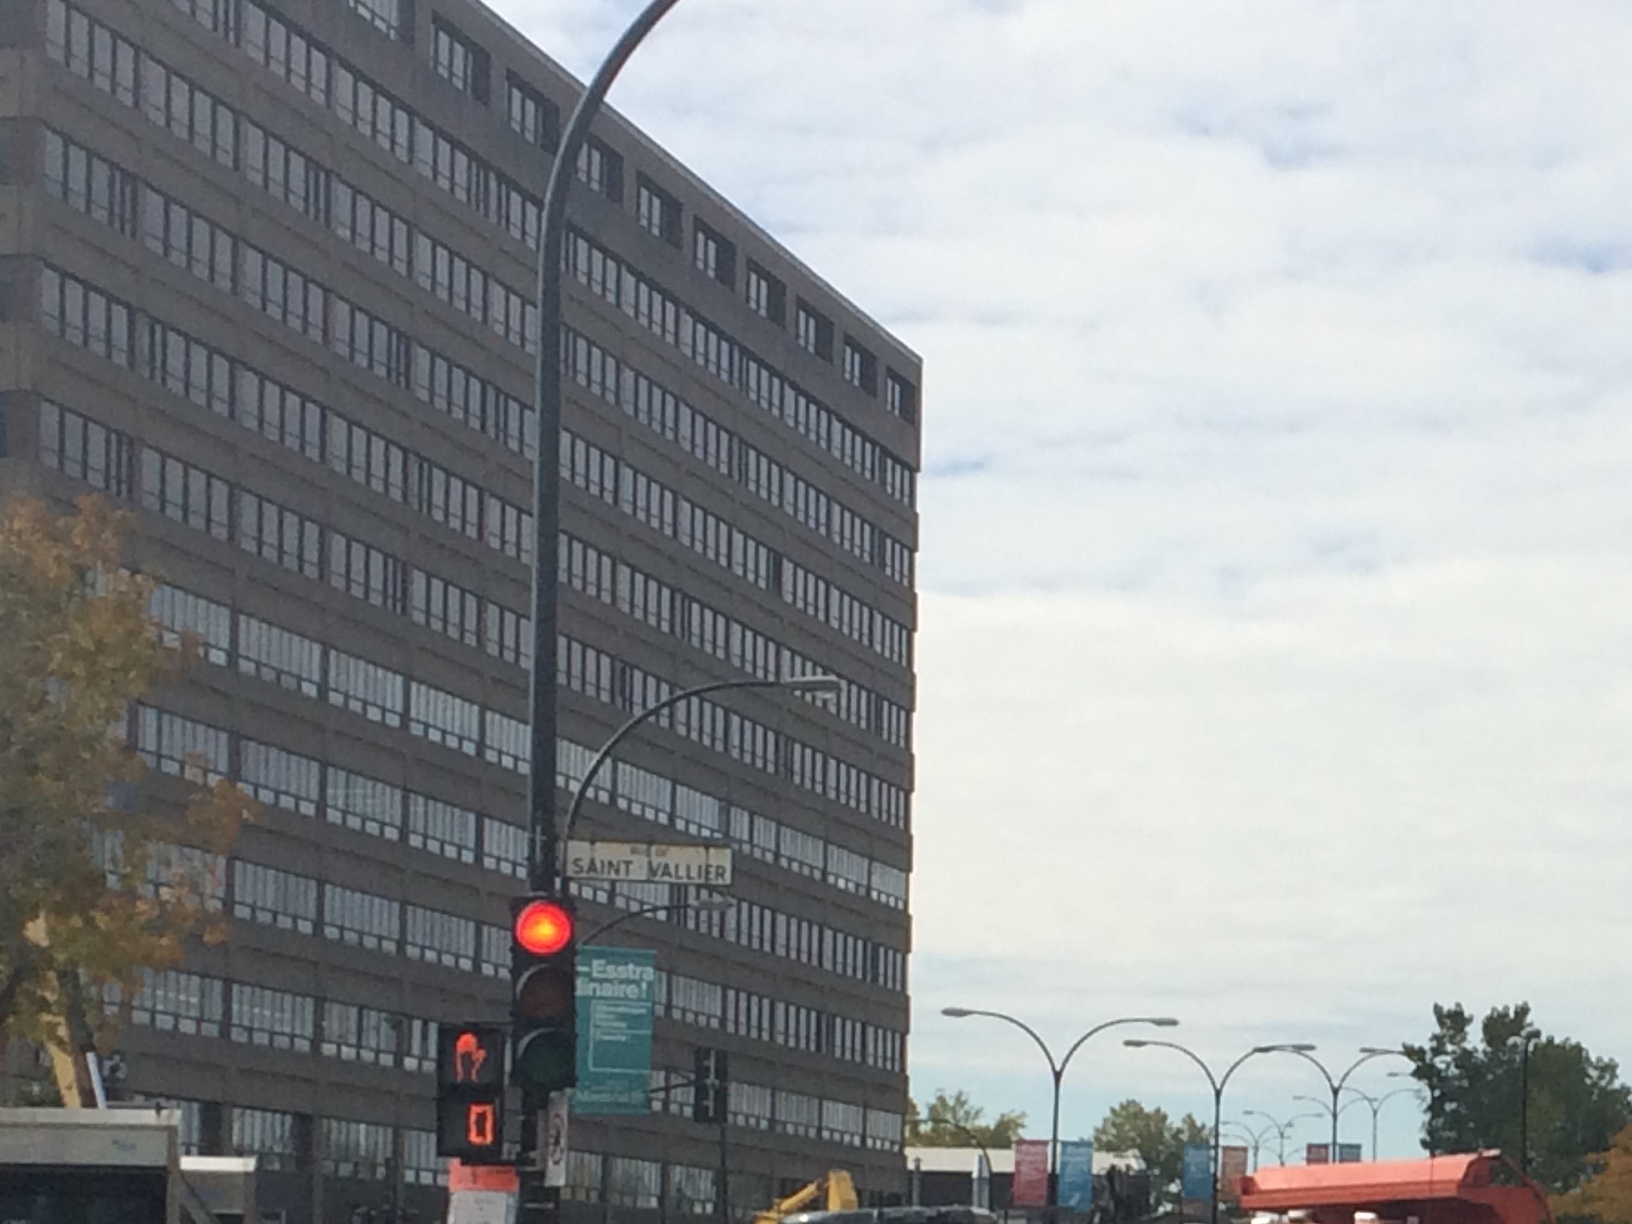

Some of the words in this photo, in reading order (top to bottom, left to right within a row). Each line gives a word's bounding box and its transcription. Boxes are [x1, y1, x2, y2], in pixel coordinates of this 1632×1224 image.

[572, 858, 633, 877] SAINT
[647, 861, 727, 882] VALLIER
[469, 1104, 494, 1145] 0
